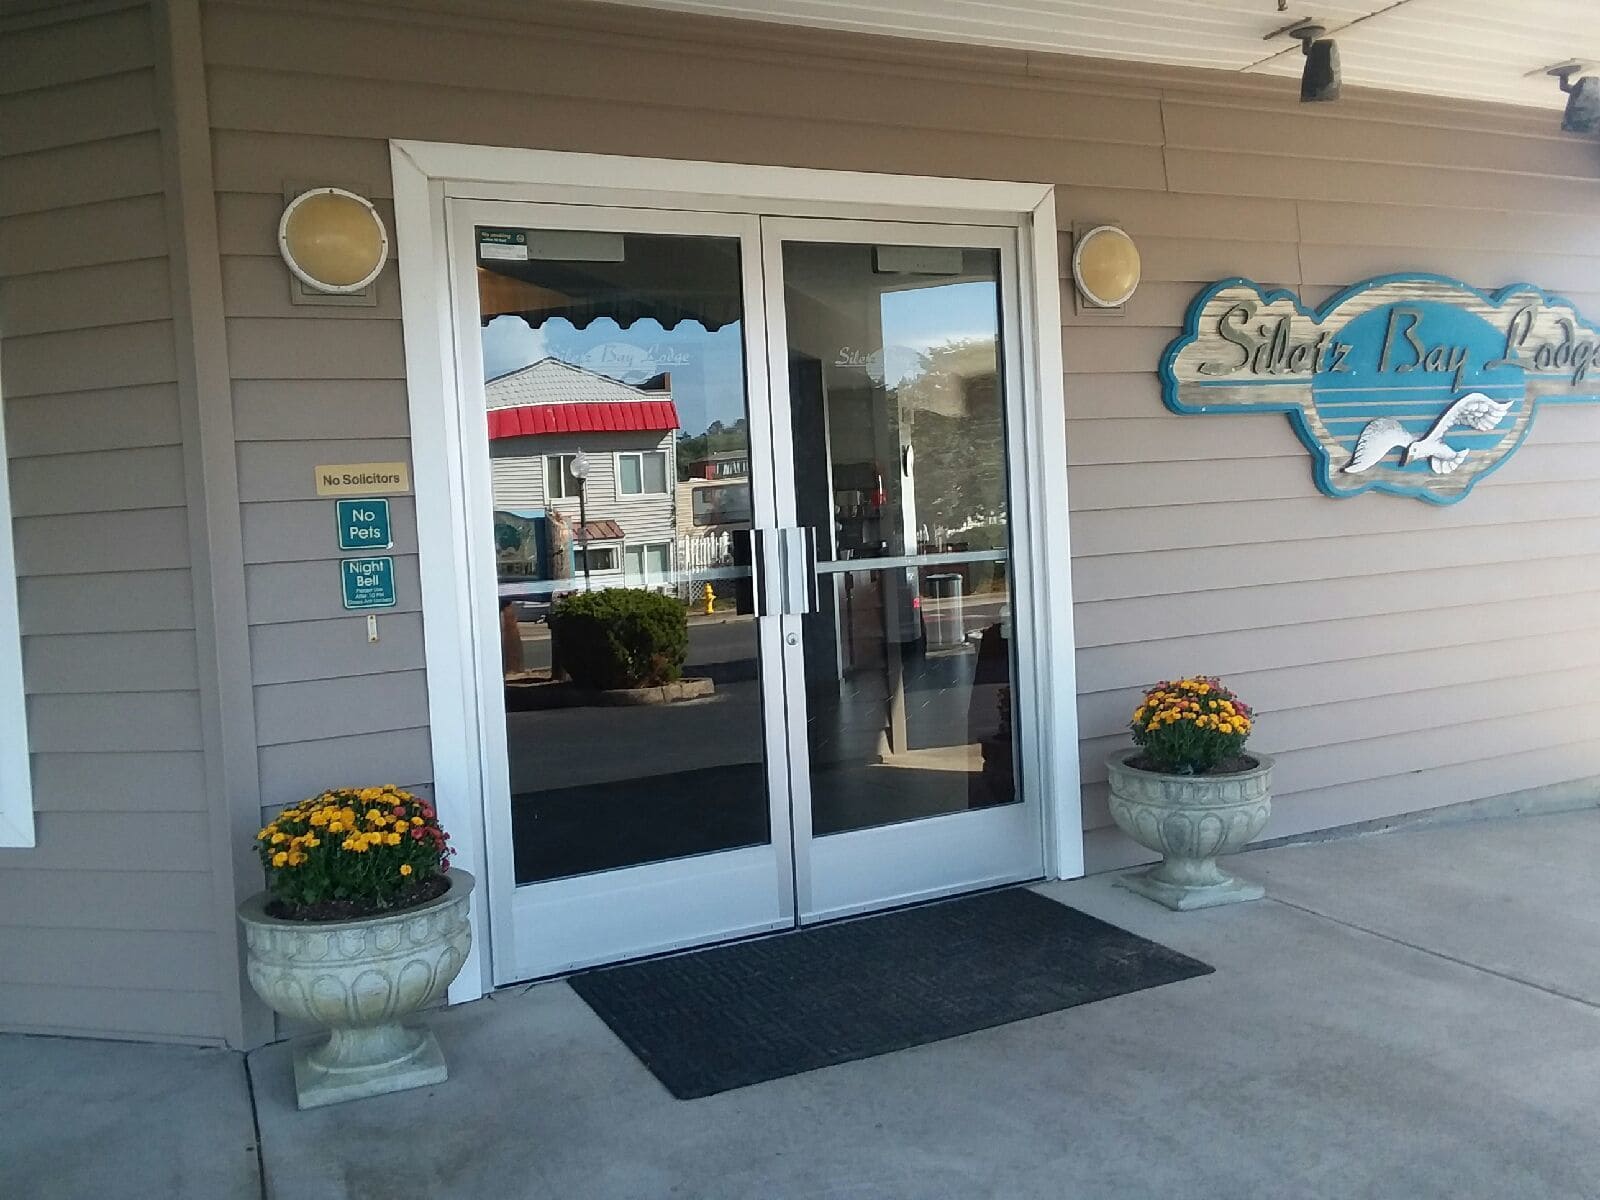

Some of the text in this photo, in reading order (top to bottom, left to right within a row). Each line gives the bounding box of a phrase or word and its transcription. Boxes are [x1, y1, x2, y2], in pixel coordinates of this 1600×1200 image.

[1198, 300, 1355, 376] Siletz
[1377, 306, 1472, 393] Bay
[323, 473, 400, 486] No Solicitors
[352, 508, 376, 522] No
[350, 526, 381, 540] Pets
[349, 560, 384, 576] Night
[356, 575, 379, 587] Bell
